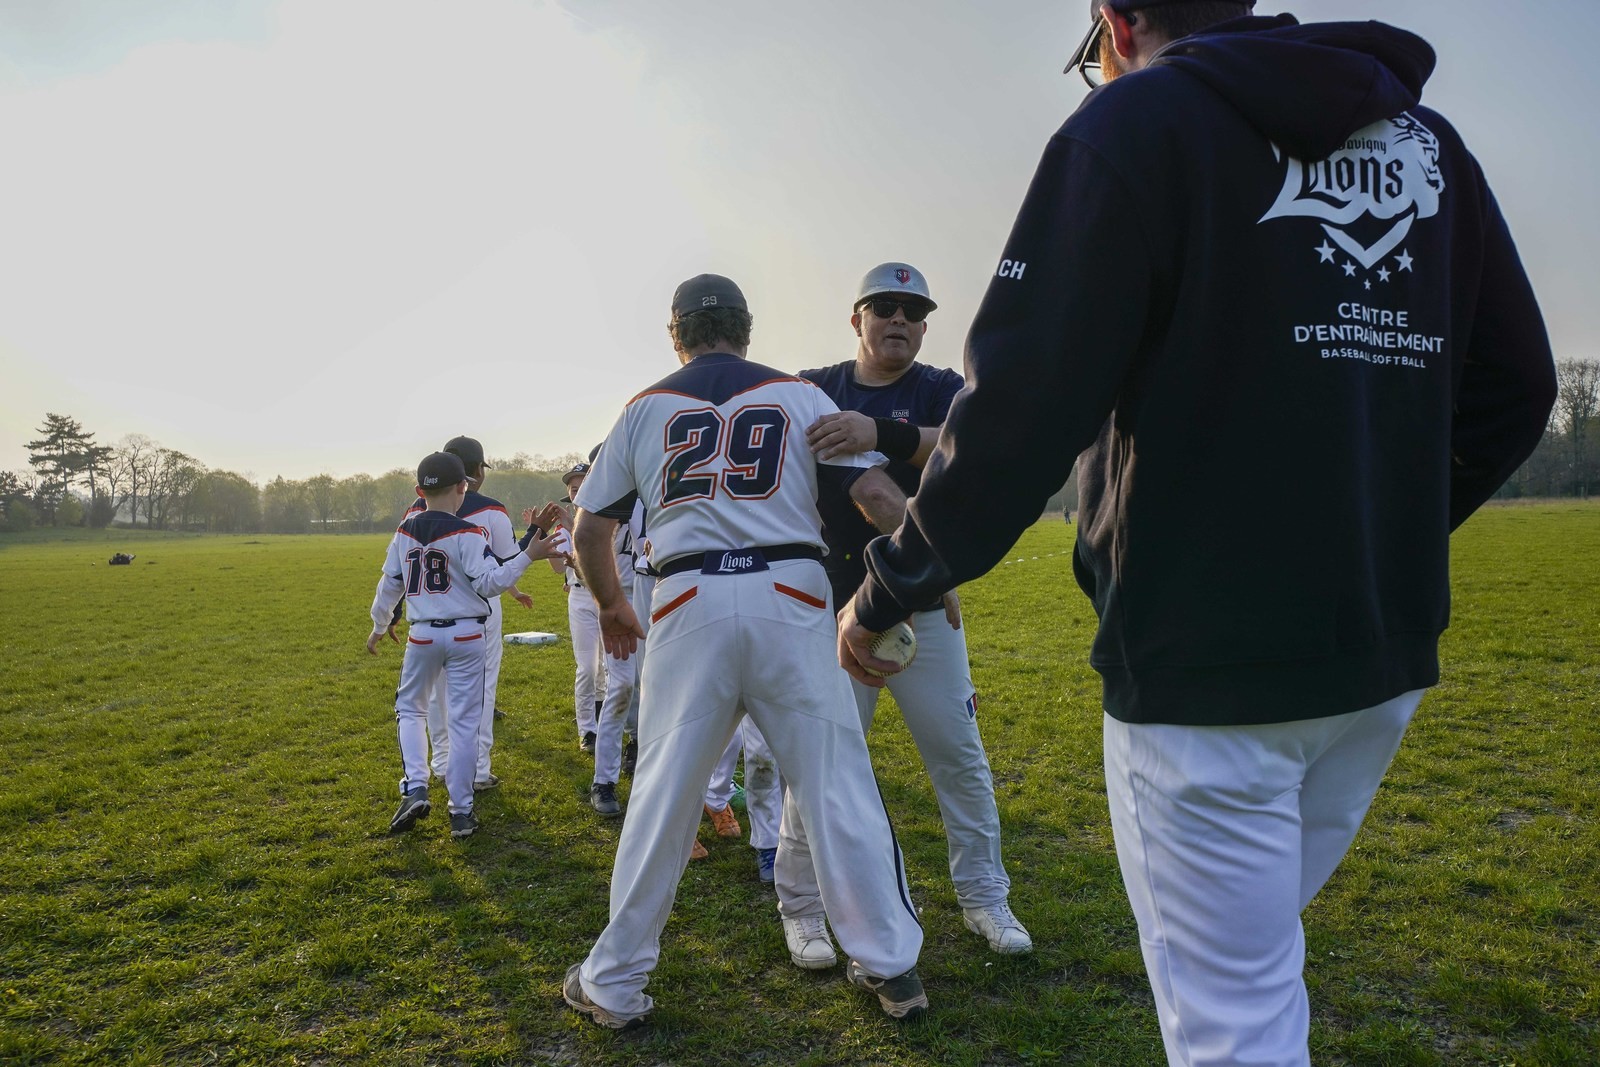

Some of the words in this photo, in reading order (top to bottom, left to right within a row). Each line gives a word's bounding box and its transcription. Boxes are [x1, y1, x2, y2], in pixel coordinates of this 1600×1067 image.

[994, 259, 1027, 280] CH
[701, 295, 718, 306] 29
[1337, 302, 1409, 328] CENTRE
[1294, 324, 1445, 353] D'ENTRAÎNEMENT
[1320, 347, 1372, 363] BASEBALL
[1372, 354, 1427, 369] SOFTBALL
[660, 404, 791, 509] 29
[405, 546, 452, 597] 18
[717, 551, 753, 573] Lions
